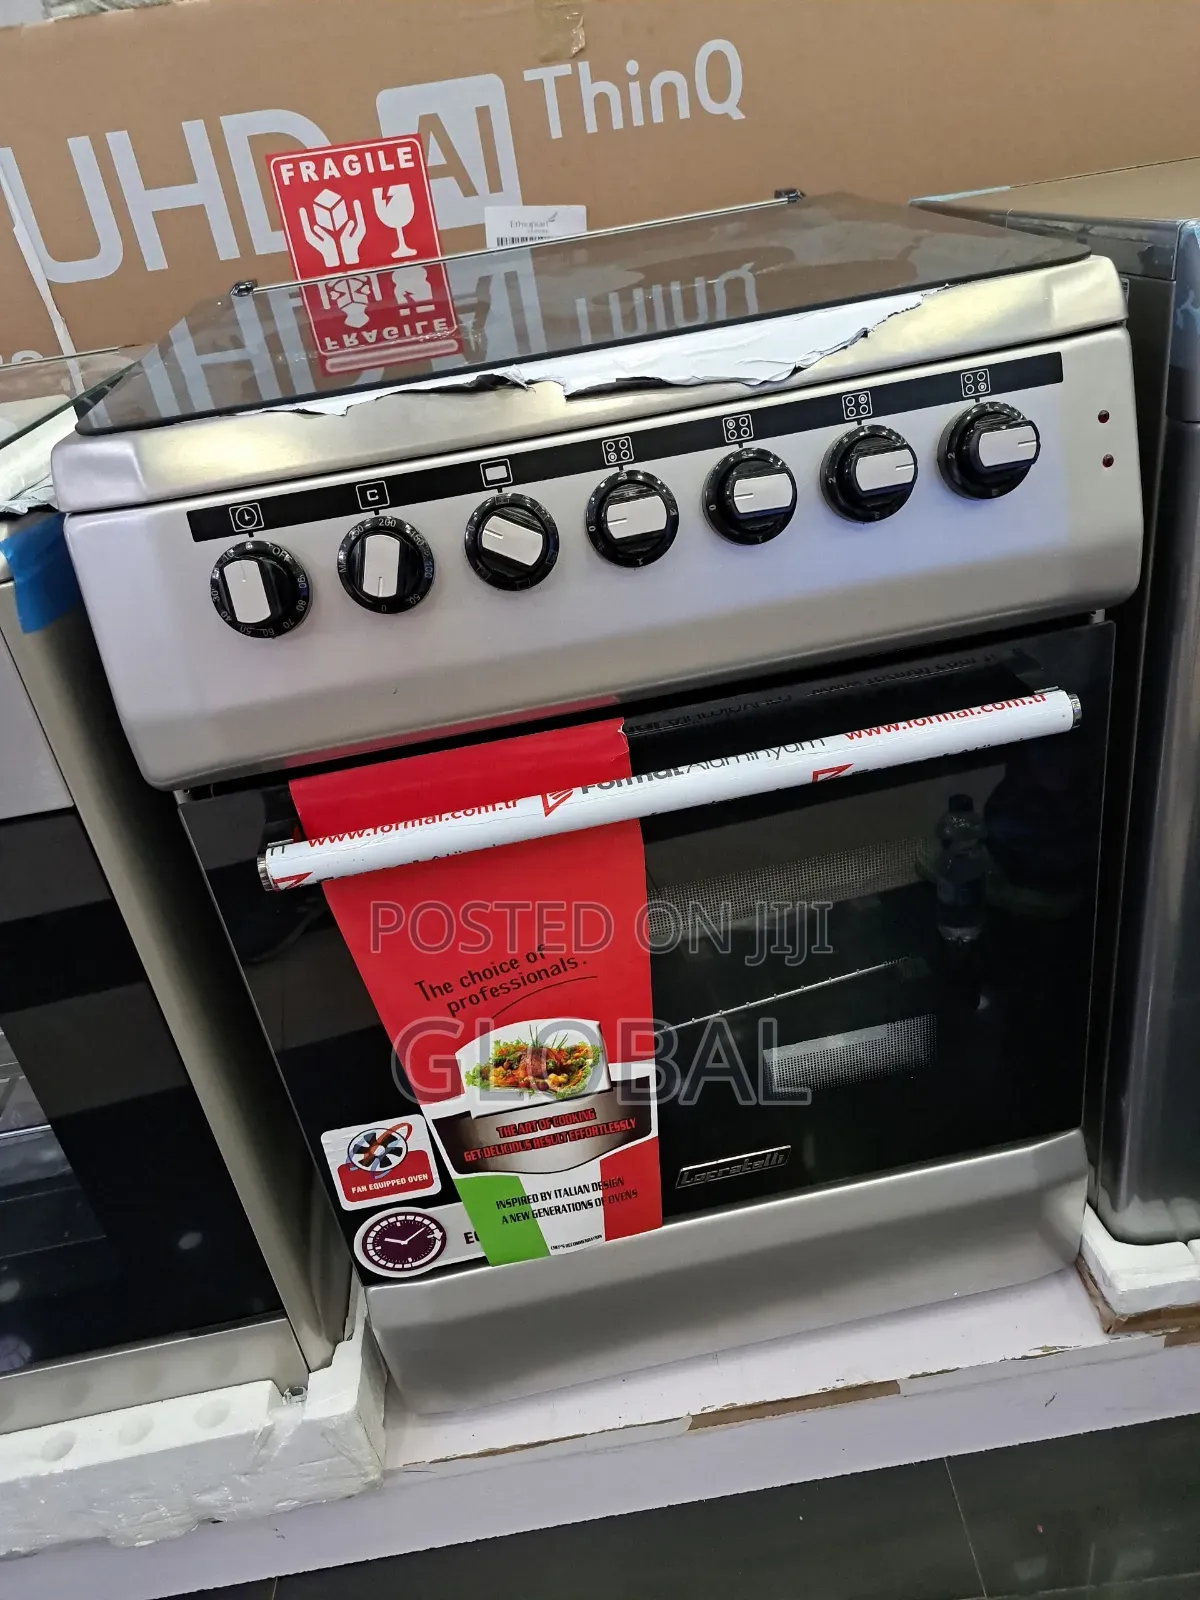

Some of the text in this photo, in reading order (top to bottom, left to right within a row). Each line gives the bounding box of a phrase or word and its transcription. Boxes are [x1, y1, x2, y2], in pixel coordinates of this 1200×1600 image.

[523, 39, 746, 139] ThinQ
[279, 146, 416, 187] FRAGILE
[0, 109, 331, 283] UHD
[366, 489, 380, 502] C
[414, 943, 547, 1002] The choice of
[446, 955, 588, 1018] professionals.
[463, 1117, 637, 1163] GET DELICIOUS RESULT EFFORTLESSLY
[496, 1107, 597, 1139] THE ART OF COOKING
[351, 1173, 429, 1195] FAN EQUIPPED OVEN
[495, 1176, 625, 1211] INSPIRED BY ITALIAN DESIGN
[502, 1215, 510, 1225] A
[510, 1211, 531, 1224] NEW
[531, 1198, 594, 1220] GENERATIONS
[608, 1188, 638, 1205] OVENS
